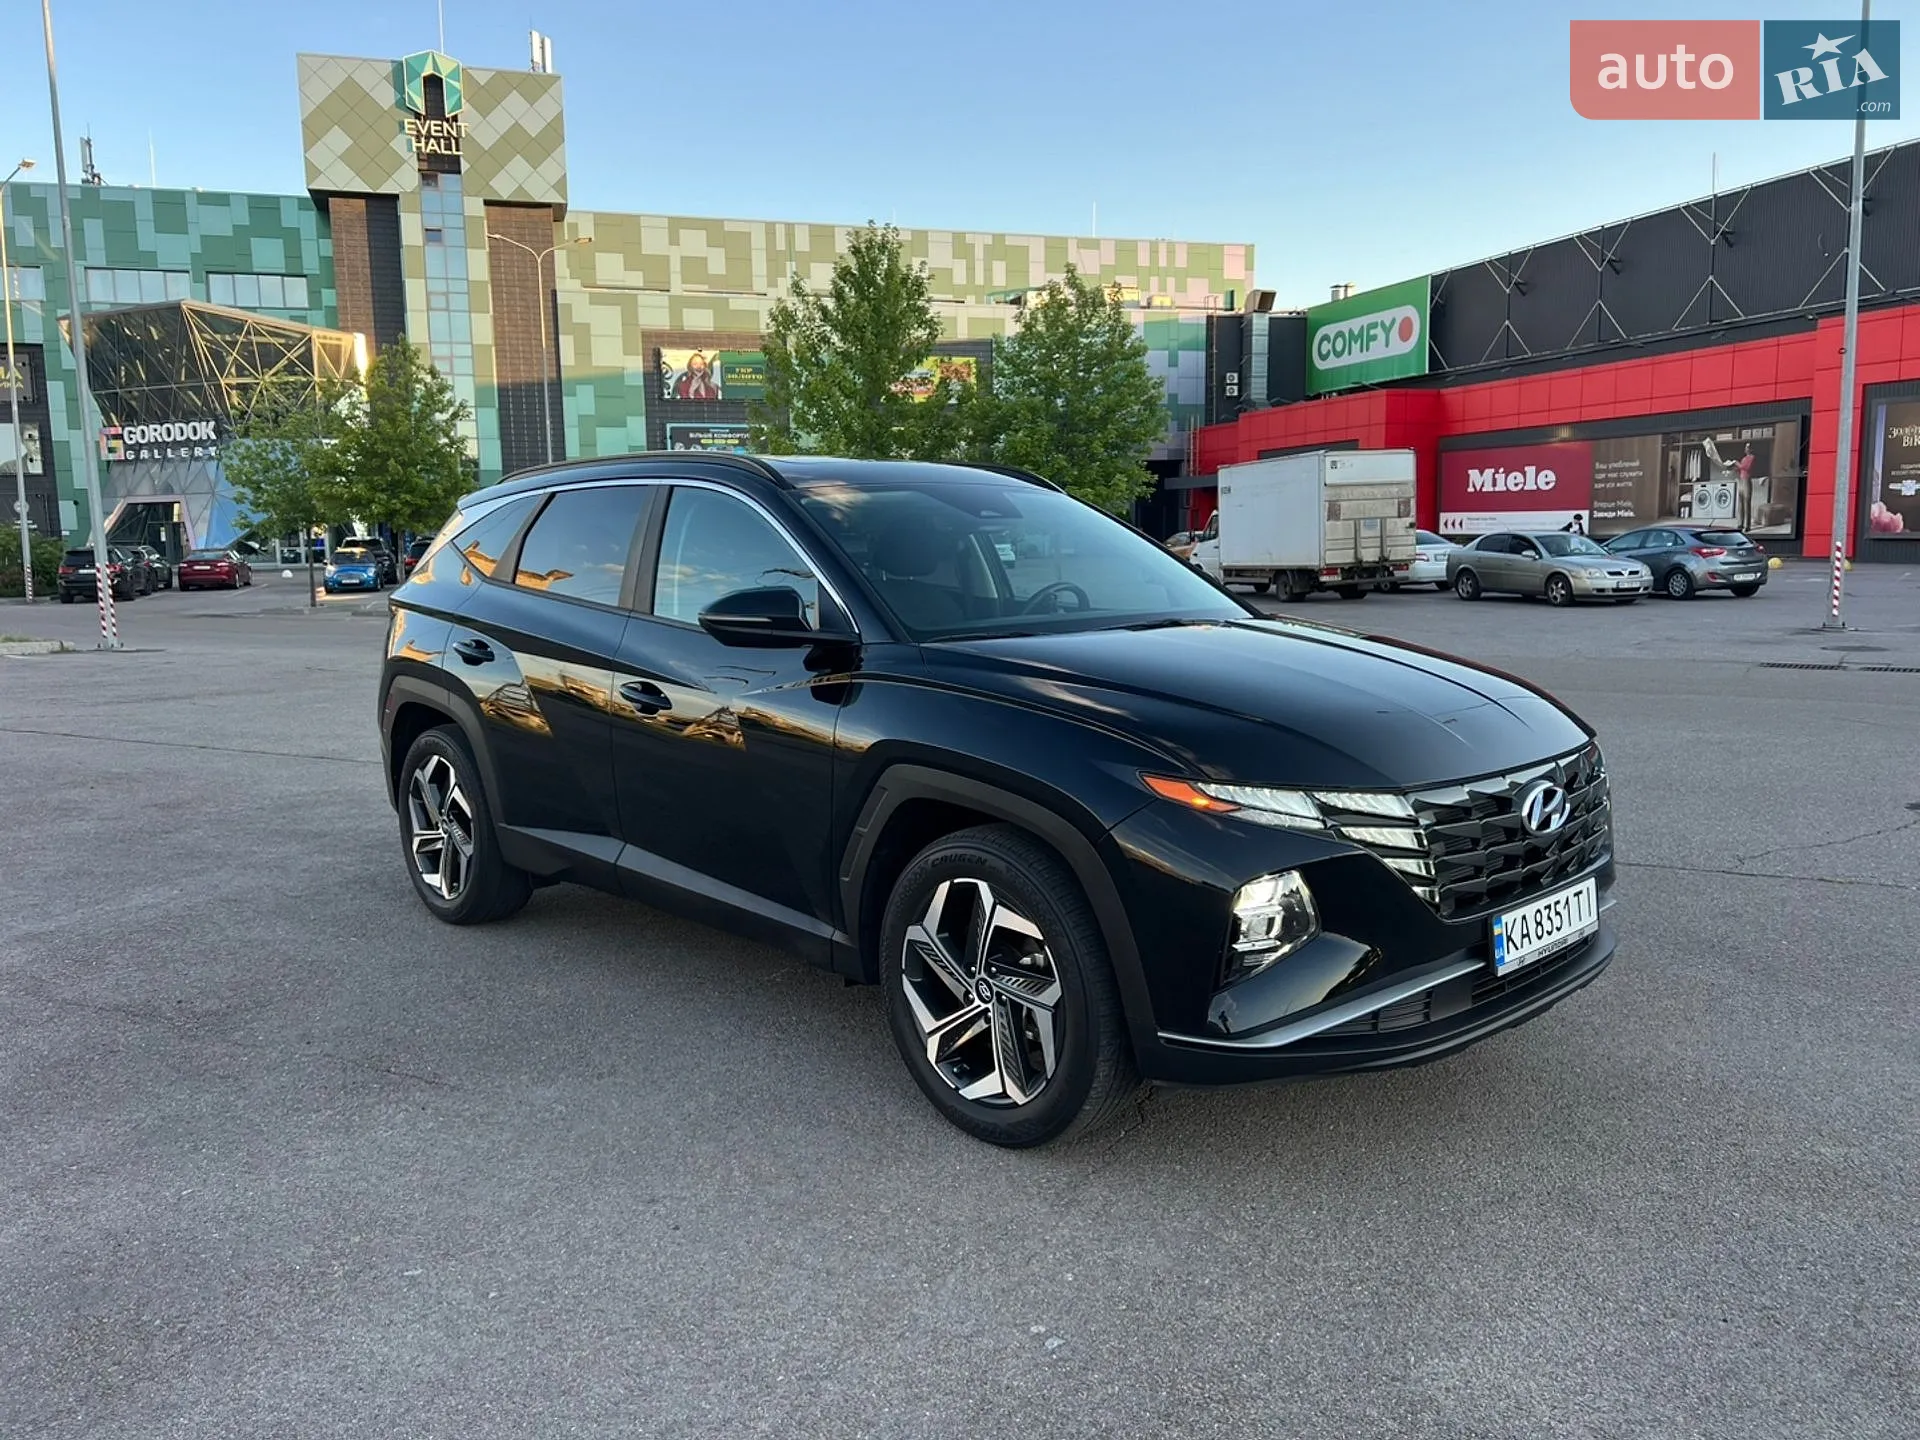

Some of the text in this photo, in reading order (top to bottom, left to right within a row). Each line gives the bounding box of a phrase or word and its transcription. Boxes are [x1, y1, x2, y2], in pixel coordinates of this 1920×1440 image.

[404, 118, 470, 137] EVENT
[411, 137, 464, 155] HALL
[1317, 316, 1397, 362] COMFY
[123, 421, 217, 445] GORODOK
[126, 446, 218, 460] GALLERY
[1467, 466, 1557, 492] Miele
